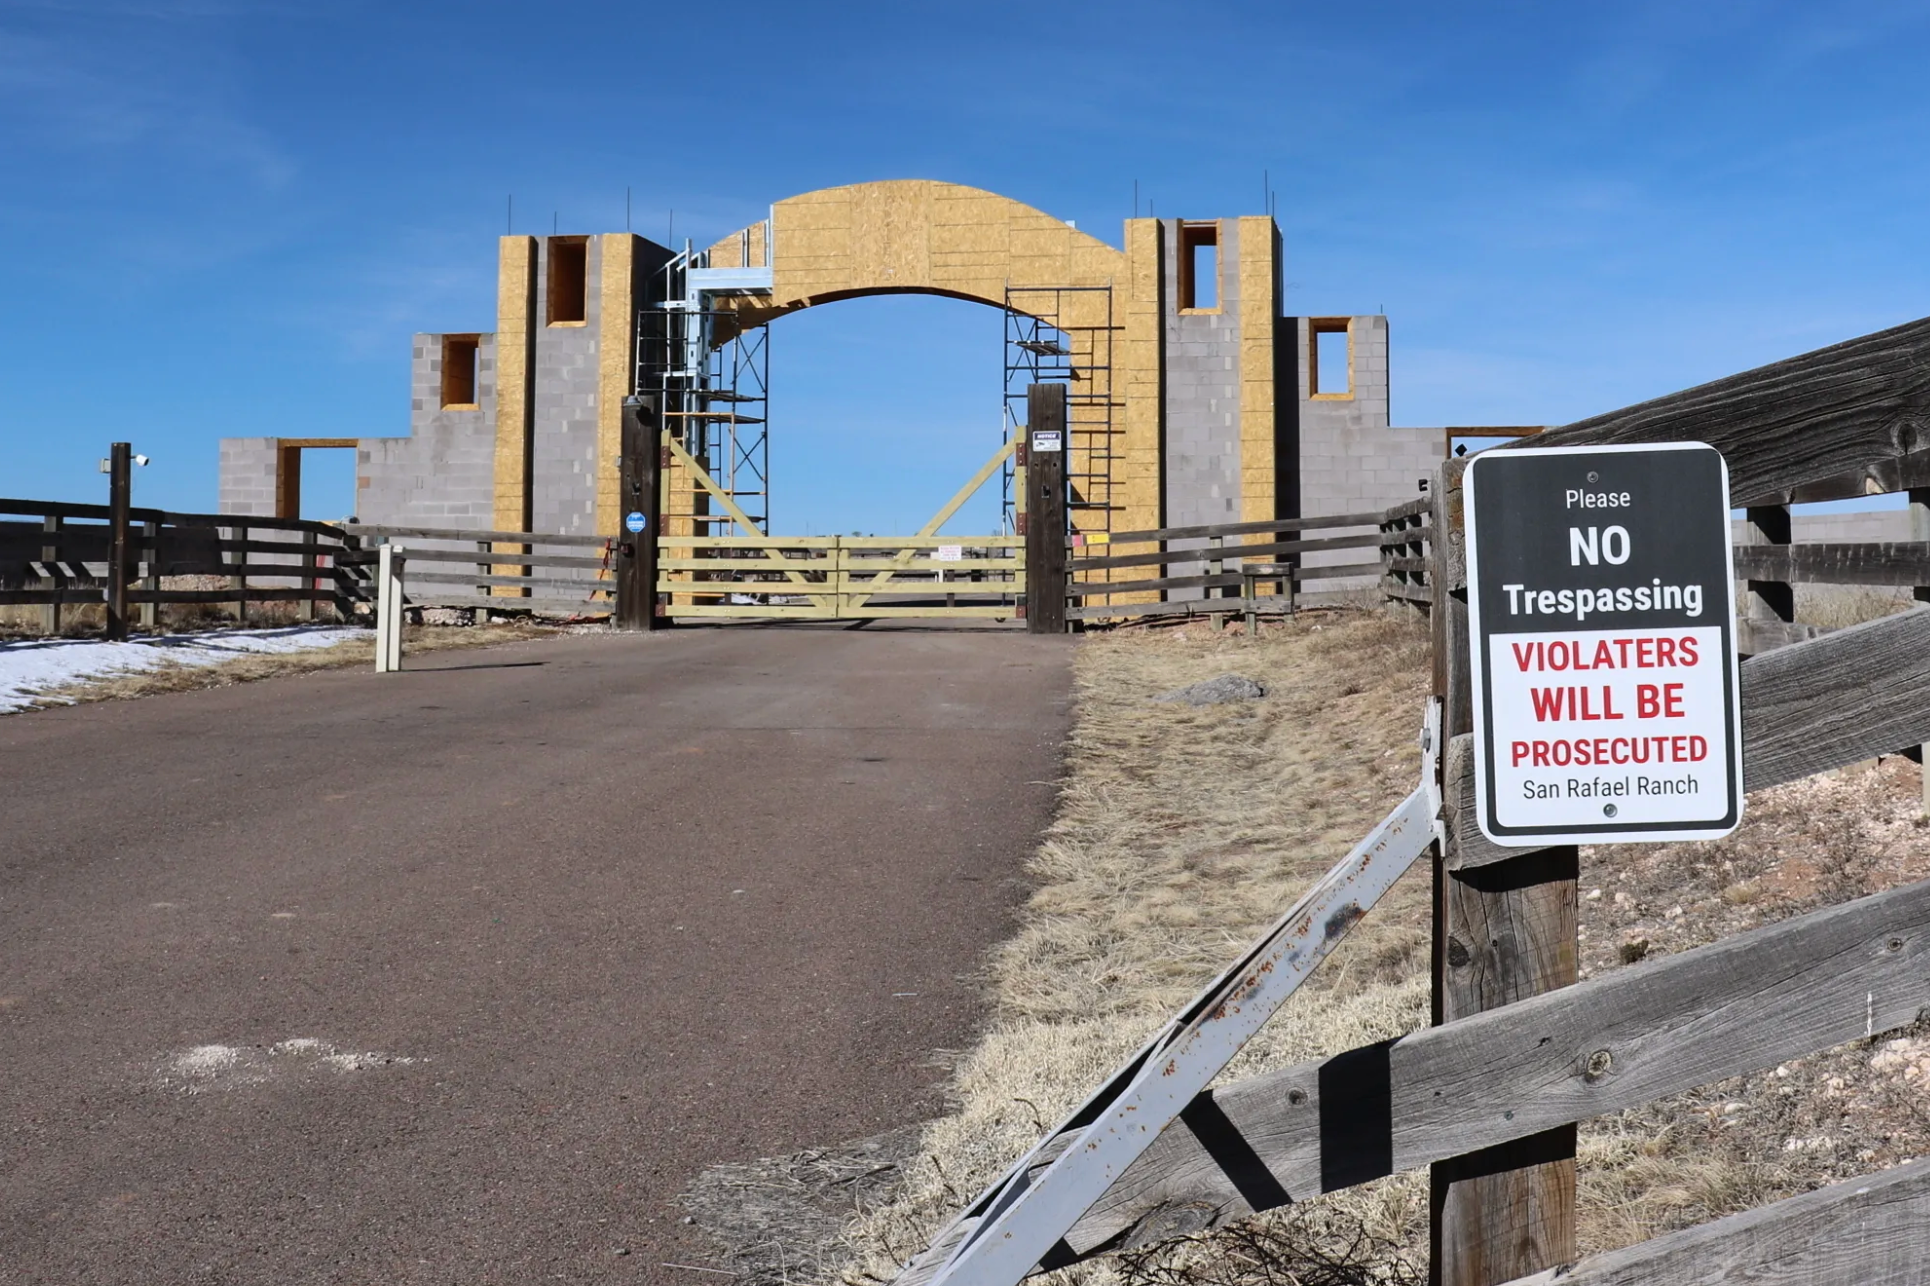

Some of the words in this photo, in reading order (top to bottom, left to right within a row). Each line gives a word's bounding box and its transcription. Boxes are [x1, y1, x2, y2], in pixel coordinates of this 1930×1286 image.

[1566, 489, 1631, 509] Please
[1569, 525, 1631, 567] NO
[1502, 578, 1703, 621] Trespassing
[1512, 636, 1699, 672] VIOLATERS
[1531, 685, 1624, 722] WILL
[1637, 683, 1686, 719] BE
[1512, 735, 1708, 768] PROSECUTED
[1523, 779, 1560, 800] San
[1567, 776, 1630, 798] Rafael
[1638, 774, 1699, 796] Ranch
